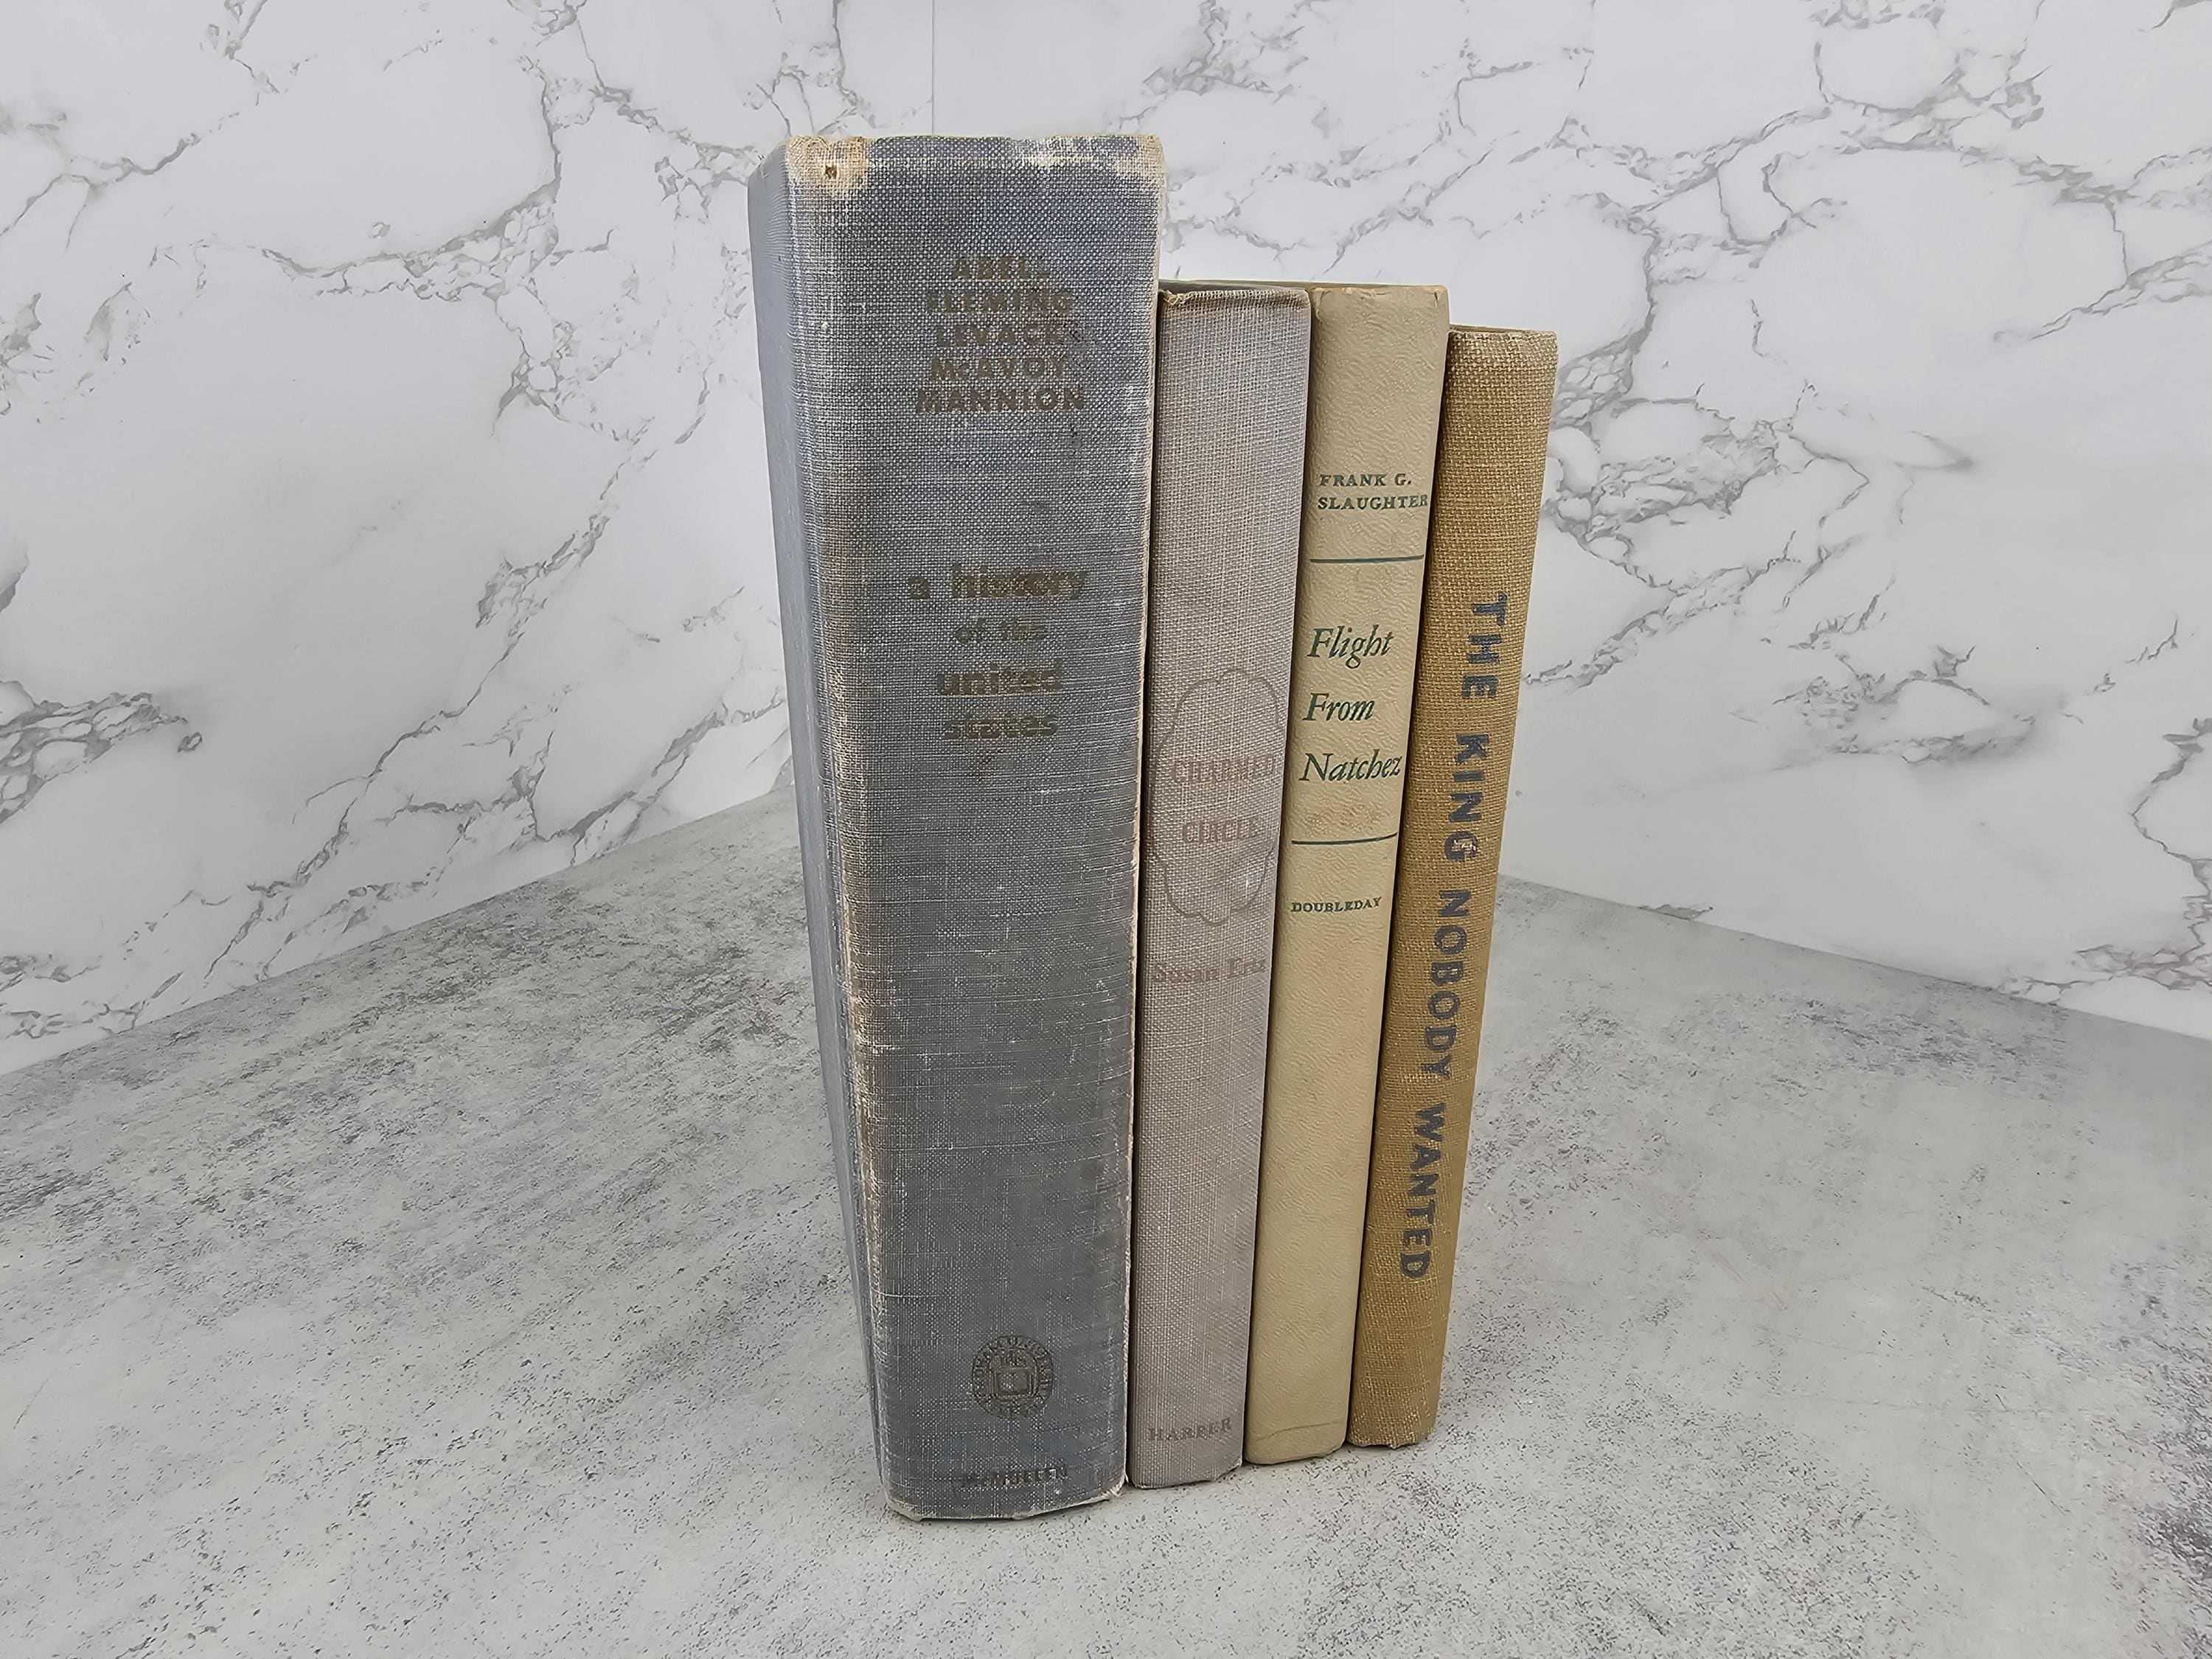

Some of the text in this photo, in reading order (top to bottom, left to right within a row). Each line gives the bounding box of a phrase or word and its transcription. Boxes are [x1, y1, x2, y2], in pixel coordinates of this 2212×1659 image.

[925, 288, 1074, 313] FLEMING
[935, 321, 1065, 347] LEVACK
[915, 386, 1085, 413] MANNION
[1319, 473, 1412, 487] FRANK G.
[1317, 494, 1428, 509] SLAUGHTER
[907, 563, 1088, 601] a history
[955, 616, 1048, 644] of the
[1307, 624, 1394, 669] Flight
[936, 658, 1063, 695] united
[1302, 692, 1375, 722] From
[942, 712, 1059, 739] states
[1171, 753, 1276, 785] CHARMED
[1298, 748, 1402, 782] Natchez
[1181, 815, 1259, 844] CIRCLE
[1290, 897, 1382, 913] DOUBLEDAY
[1401, 592, 1509, 1280] THE KING NOBODY WANTED
[1152, 962, 1220, 984] Susan
[1149, 1416, 1232, 1441] HARPER
